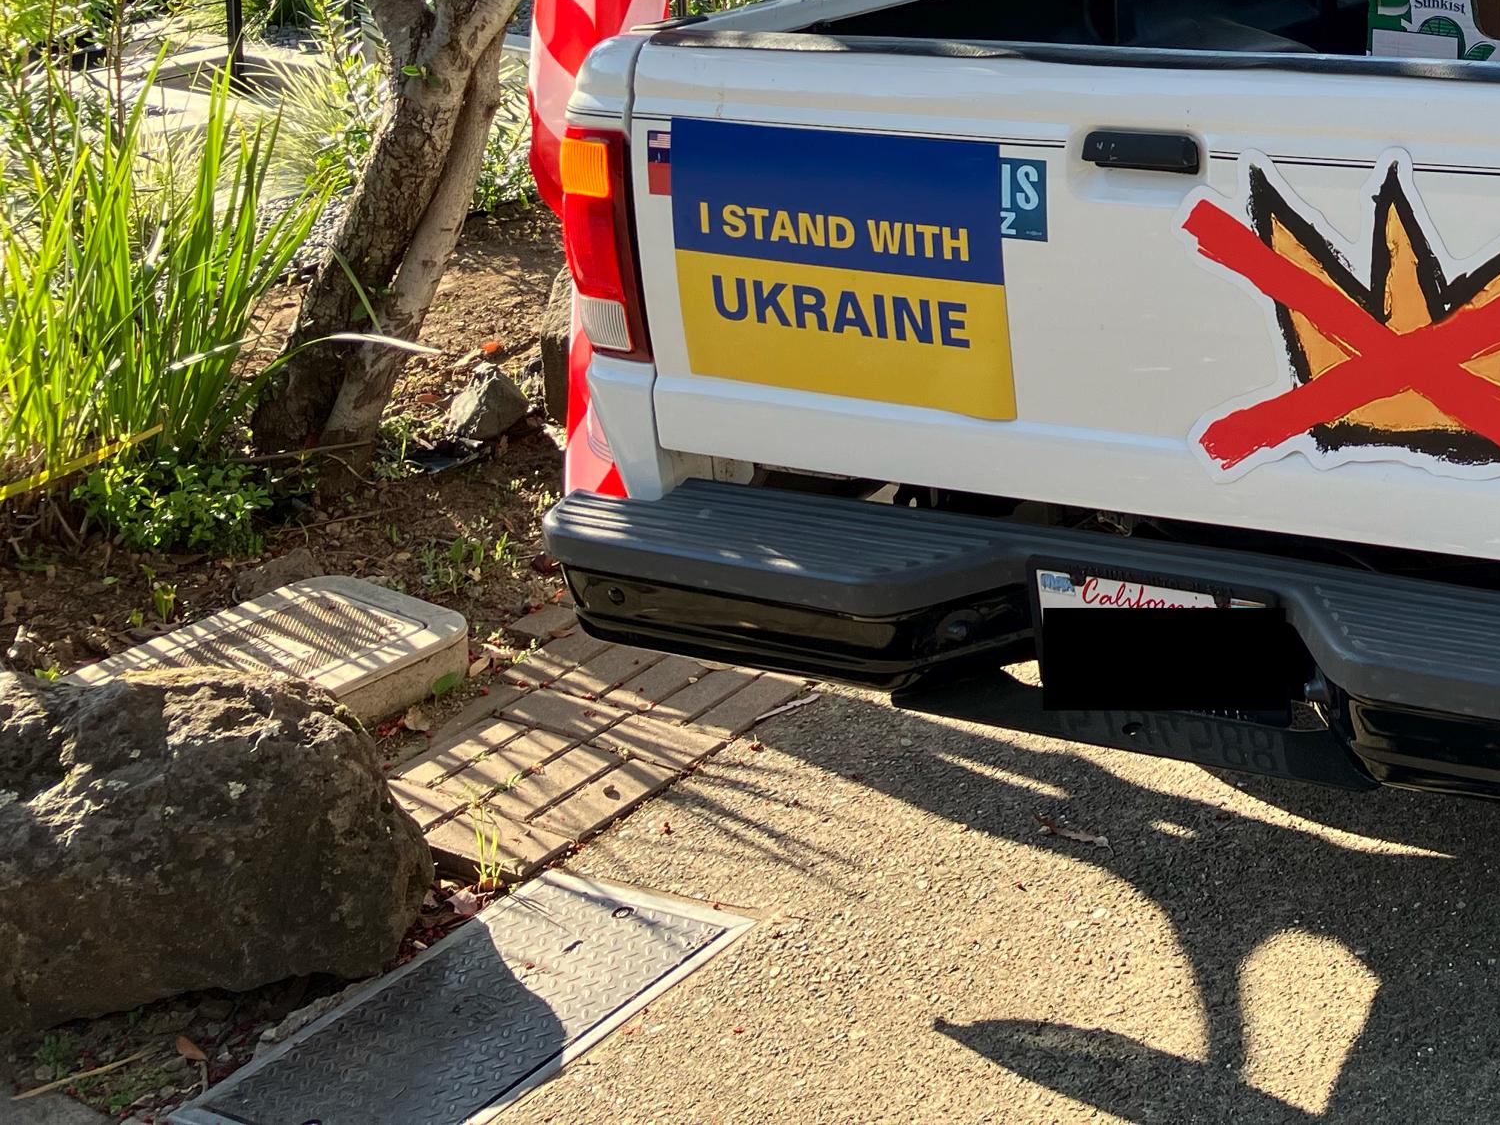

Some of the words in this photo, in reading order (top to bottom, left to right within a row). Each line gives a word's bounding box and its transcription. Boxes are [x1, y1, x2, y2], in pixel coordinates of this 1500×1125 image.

[700, 202, 709, 233] I
[723, 204, 855, 249] STAND
[868, 219, 970, 261] WITH
[712, 275, 971, 348] UKRAINE
